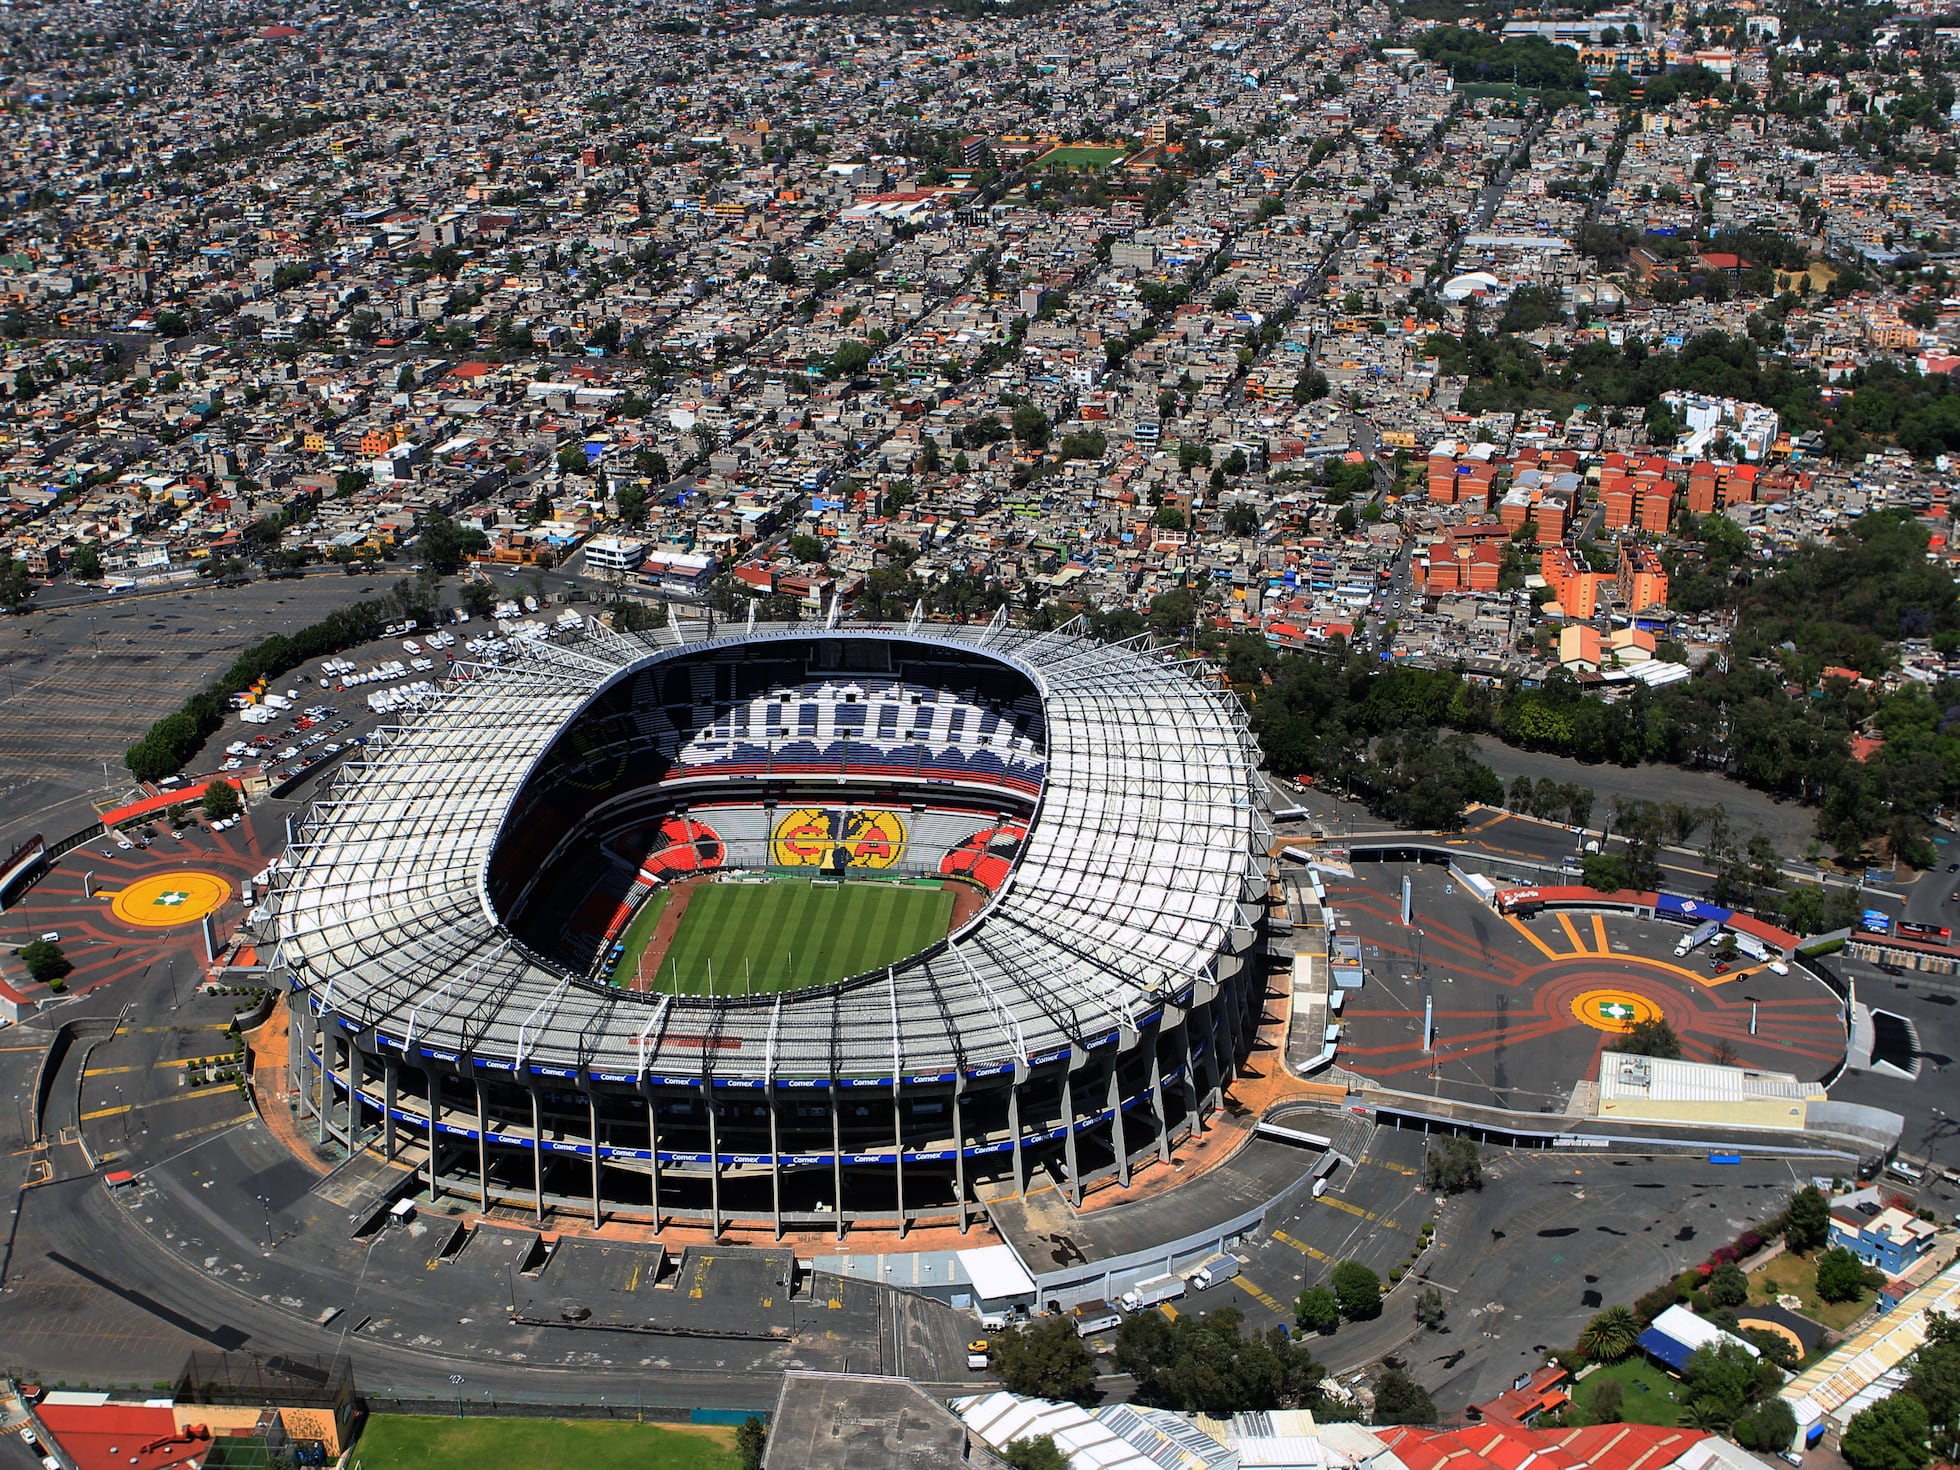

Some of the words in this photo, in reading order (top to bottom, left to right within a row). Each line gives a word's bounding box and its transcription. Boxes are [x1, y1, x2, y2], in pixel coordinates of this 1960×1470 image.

[1086, 1036, 1109, 1050] Comex
[433, 1052, 457, 1062] Comex
[1035, 1053, 1059, 1065] Comex
[486, 1061, 511, 1070] Comex
[541, 1068, 566, 1077] Comex
[975, 1066, 1002, 1077] Comex
[600, 1073, 626, 1082] Comex
[664, 1078, 691, 1086] Comex
[852, 1078, 880, 1086] Comex
[912, 1074, 940, 1084] Comex
[727, 1080, 754, 1088] Comex
[788, 1079, 816, 1087] Comex
[402, 1114, 423, 1125] Comex
[446, 1125, 469, 1136] Comex
[498, 1135, 523, 1144] Comex
[1030, 1132, 1055, 1143] Comex
[552, 1143, 578, 1151] Comex
[974, 1143, 1001, 1154] Comex
[611, 1149, 637, 1157] Comex
[671, 1153, 699, 1161] Comex
[915, 1151, 943, 1160] Comex
[733, 1155, 760, 1163] Comex
[793, 1156, 820, 1164] Comex
[854, 1154, 882, 1162] Comex
